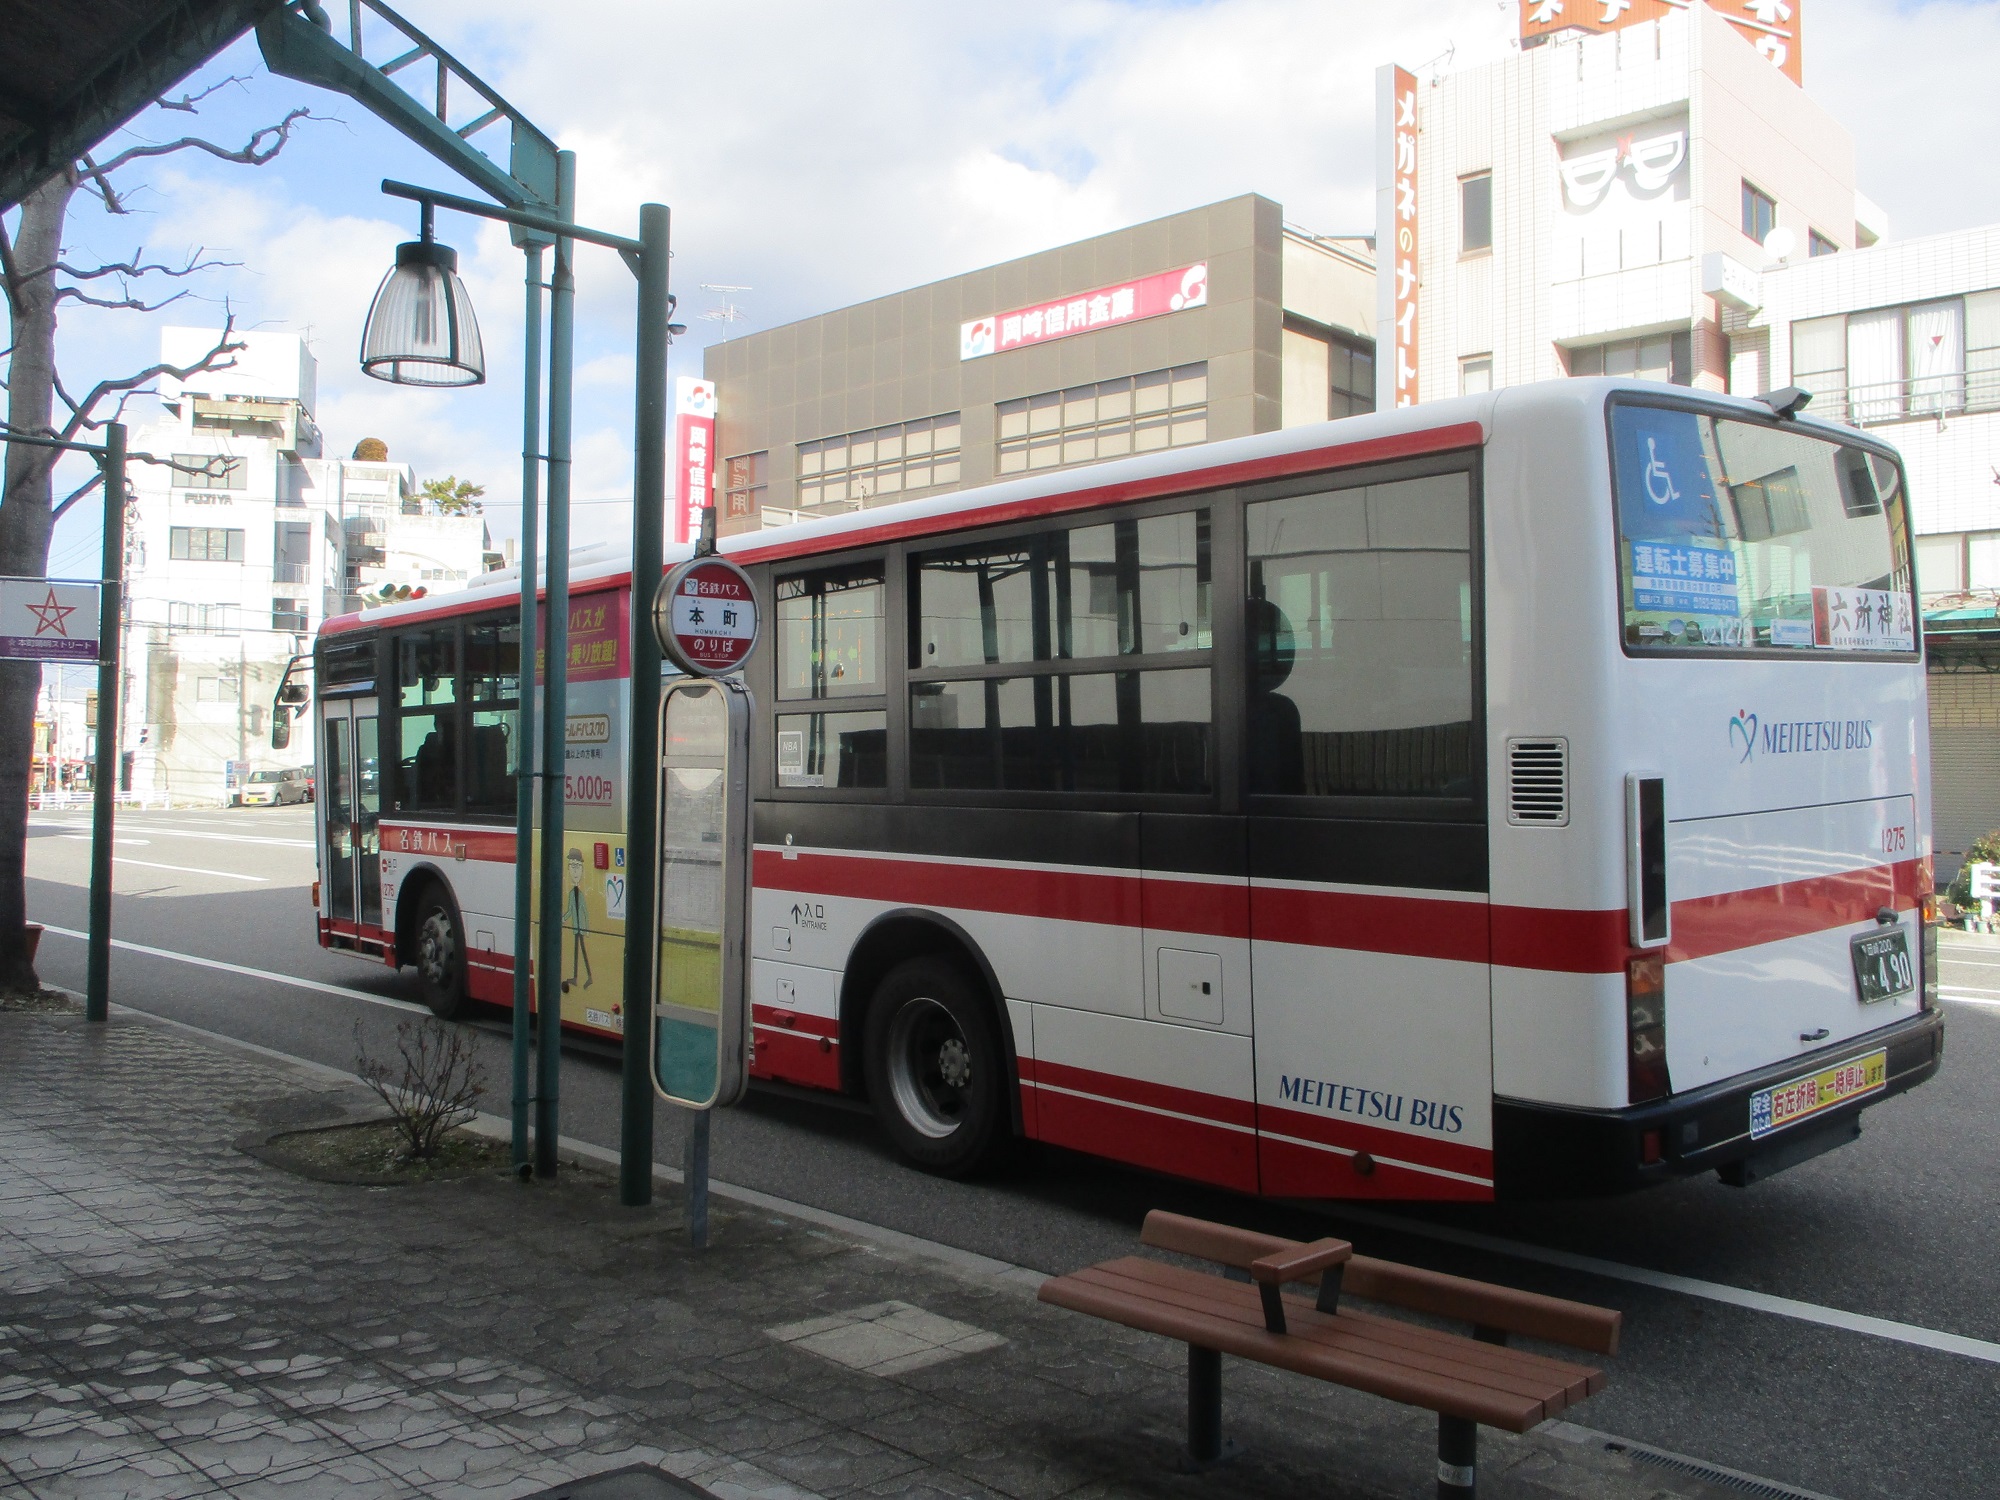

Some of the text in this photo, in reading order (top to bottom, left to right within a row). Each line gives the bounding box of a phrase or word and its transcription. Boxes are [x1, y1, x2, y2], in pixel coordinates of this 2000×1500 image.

[1634, 544, 1734, 581] 運転士募集中
[699, 581, 740, 596] 名鉄バス
[1831, 592, 1911, 638] 六所神社
[693, 638, 735, 653] のりば
[1762, 719, 1873, 755] MEITETSU BUS
[400, 829, 452, 854] 名鉄バス
[1881, 826, 1906, 853] 1275
[804, 903, 824, 918] 入口
[801, 920, 827, 931] ENTRANCE
[1279, 1074, 1464, 1134] MEITETSU BUS
